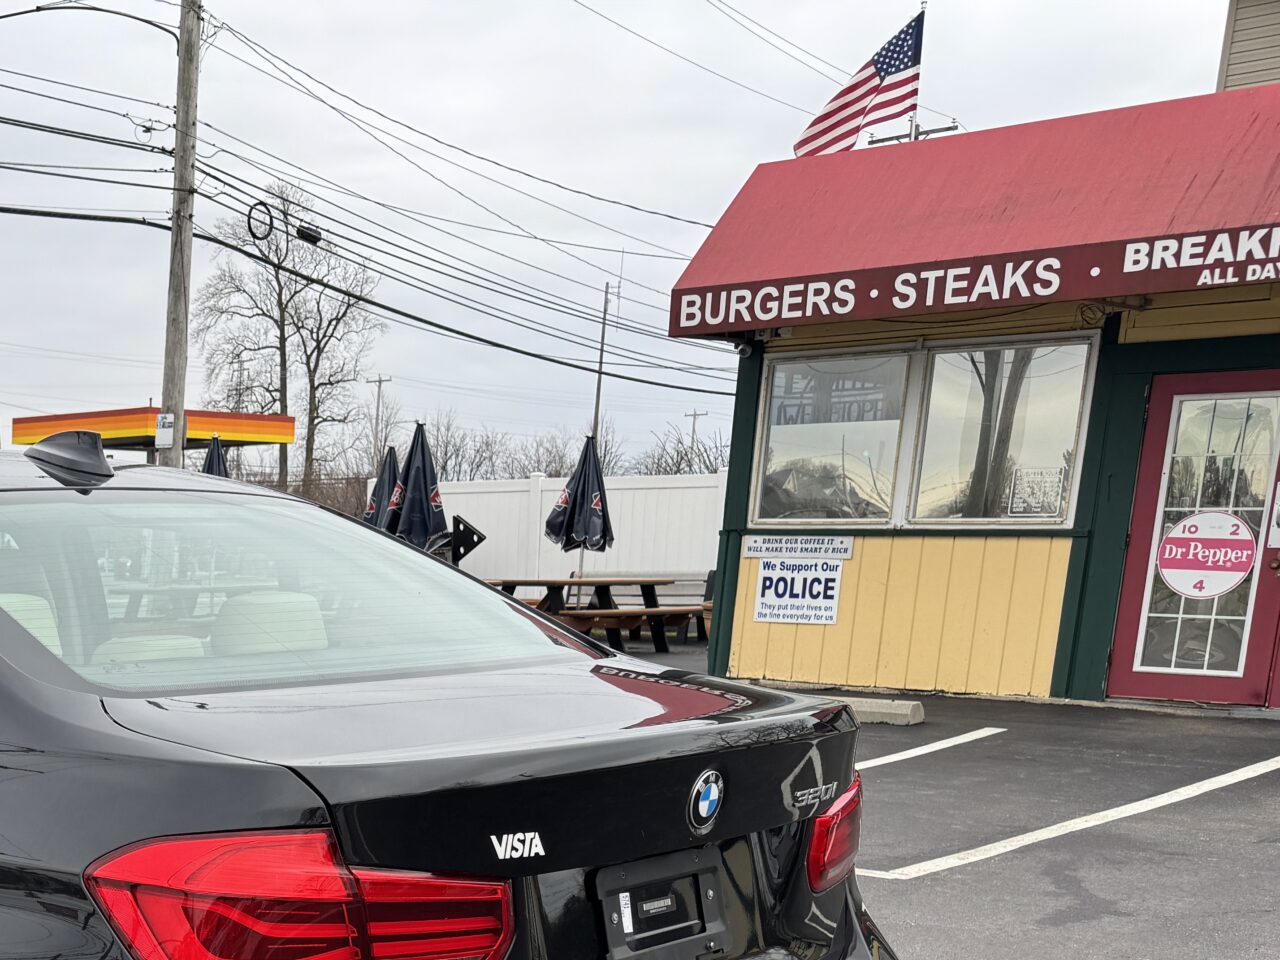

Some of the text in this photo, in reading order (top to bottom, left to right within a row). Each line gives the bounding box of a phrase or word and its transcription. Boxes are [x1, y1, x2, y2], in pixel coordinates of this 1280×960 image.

[1196, 266, 1239, 285] ALL
[679, 278, 856, 328] BURGERS
[892, 257, 1062, 309] STEAKS
[1182, 524, 1240, 535] 10 2
[1163, 544, 1186, 559] Dr
[762, 561, 840, 573] We Support Our
[761, 576, 836, 600] POLICE
[1193, 579, 1205, 592] 4
[760, 602, 776, 611] They
[777, 603, 789, 611] put
[790, 602, 805, 610] their
[806, 603, 822, 611] lives
[782, 612, 813, 622] everyday
[813, 612, 824, 621] for
[490, 832, 545, 859] VISTA
